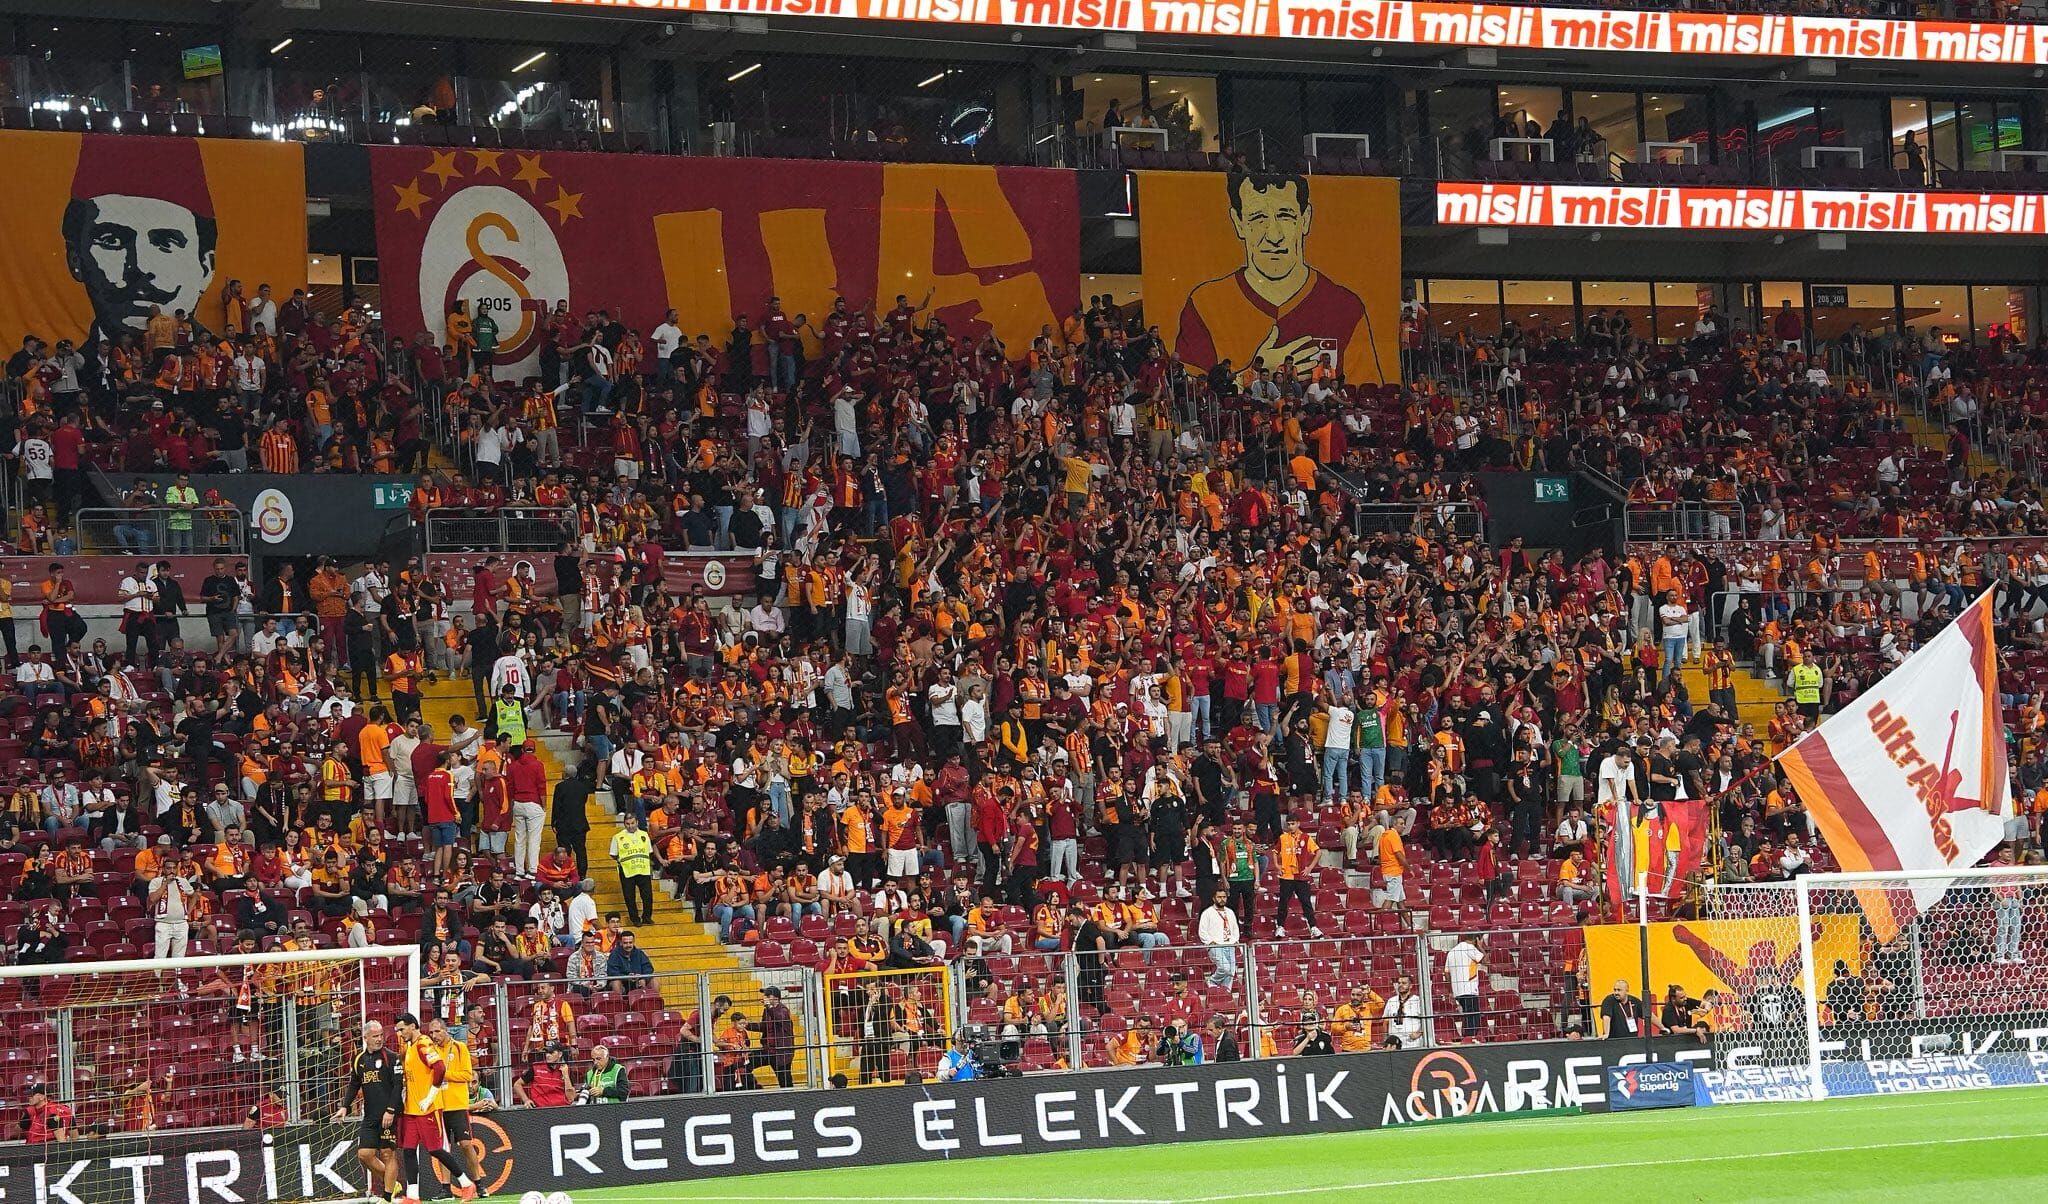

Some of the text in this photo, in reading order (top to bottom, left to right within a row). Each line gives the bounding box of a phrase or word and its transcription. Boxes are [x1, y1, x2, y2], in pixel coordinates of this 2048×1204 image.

[1151, 0, 1270, 34] misli
[1288, 1, 1403, 39] misli
[1420, 5, 1534, 45] misli
[1551, 12, 1663, 49] misli
[1677, 16, 1790, 54] misli
[1801, 21, 1907, 56] misli
[1922, 24, 2028, 61] misli
[1438, 183, 2039, 231] misli misli misli misli misli
[28, 447, 46, 461] 53
[505, 669, 520, 684] 10
[1638, 1069, 1689, 1085] trendyol
[550, 1063, 1354, 1177] REGES ELEKTRİK
[0, 1133, 359, 1204] KTRİK
